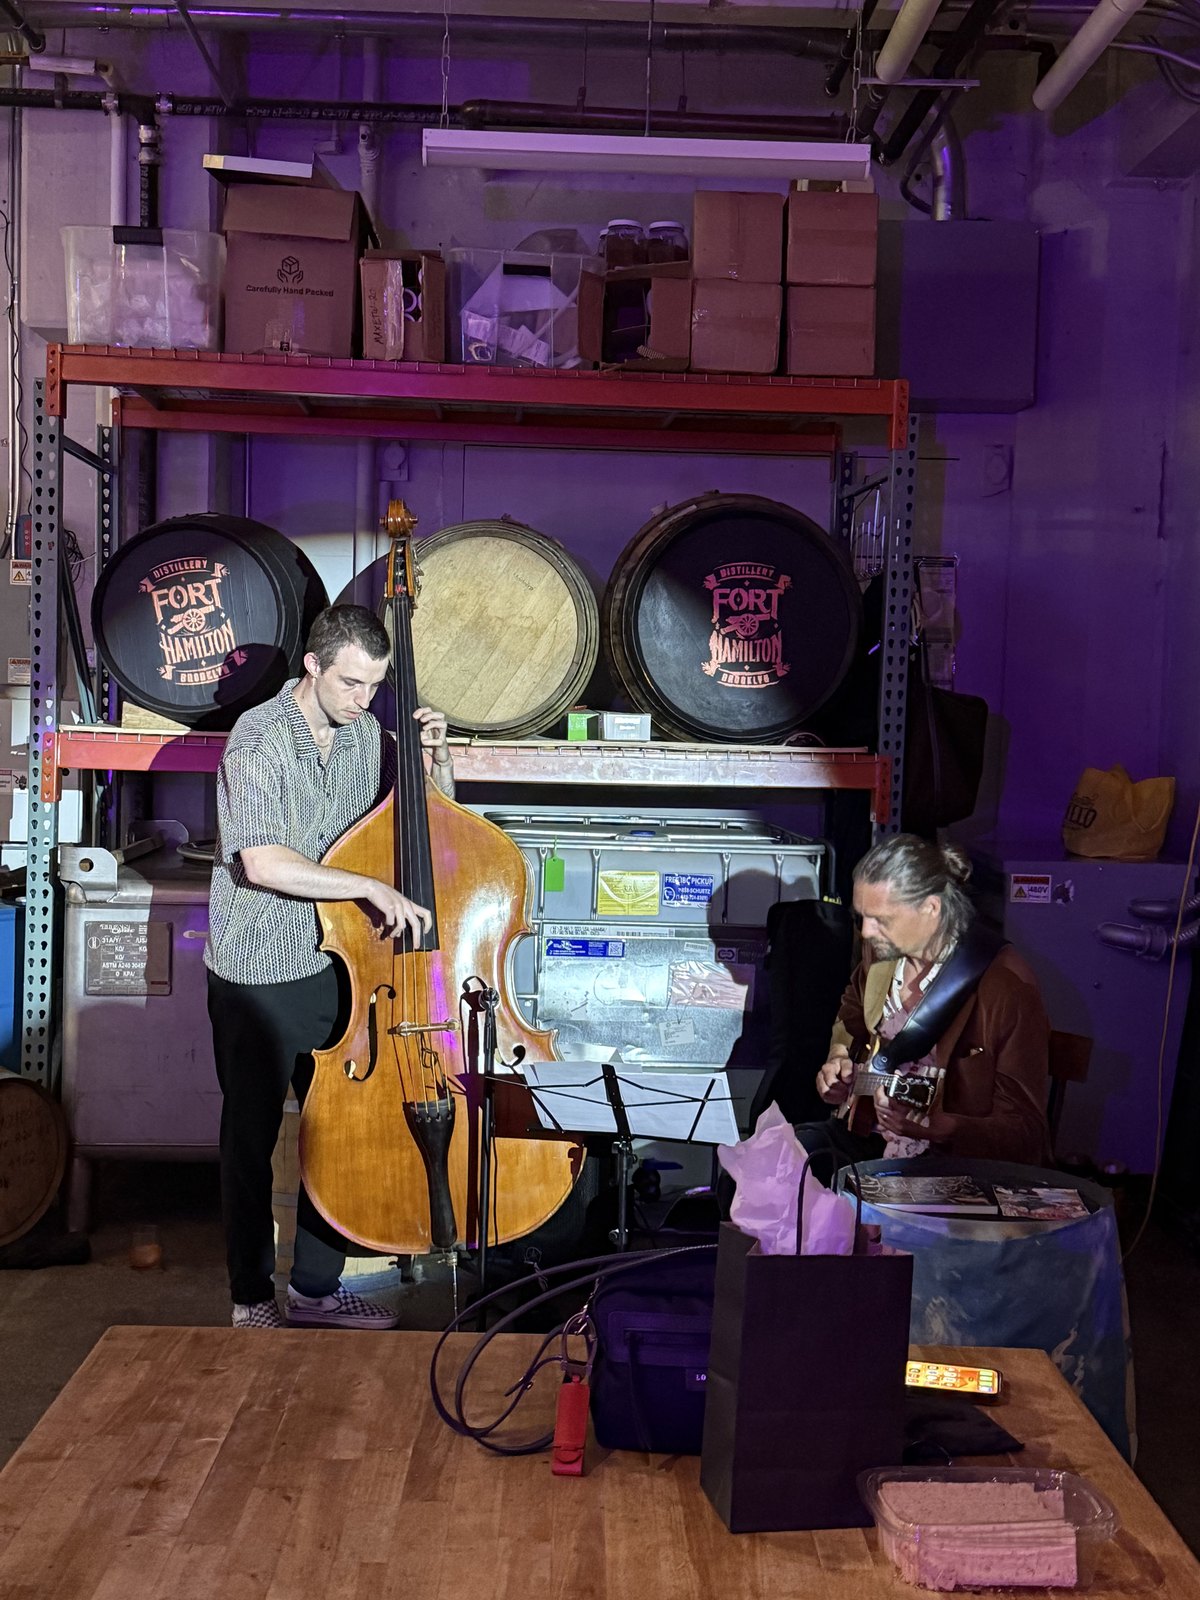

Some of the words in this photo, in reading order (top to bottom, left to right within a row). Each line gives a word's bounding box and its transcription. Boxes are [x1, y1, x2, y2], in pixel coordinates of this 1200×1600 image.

[246, 285, 281, 295] Carefully
[283, 286, 304, 295] Hand
[305, 288, 334, 297] Packed
[153, 559, 208, 578] DISTILLERY
[720, 566, 775, 578] DISTILLERY
[152, 578, 223, 625] FORT
[711, 588, 784, 623] FORT
[159, 618, 236, 665] HAMILTON
[709, 630, 782, 663] HAMILTON
[180, 664, 230, 682] BROOKLYN
[721, 673, 770, 685] BROOKLYN
